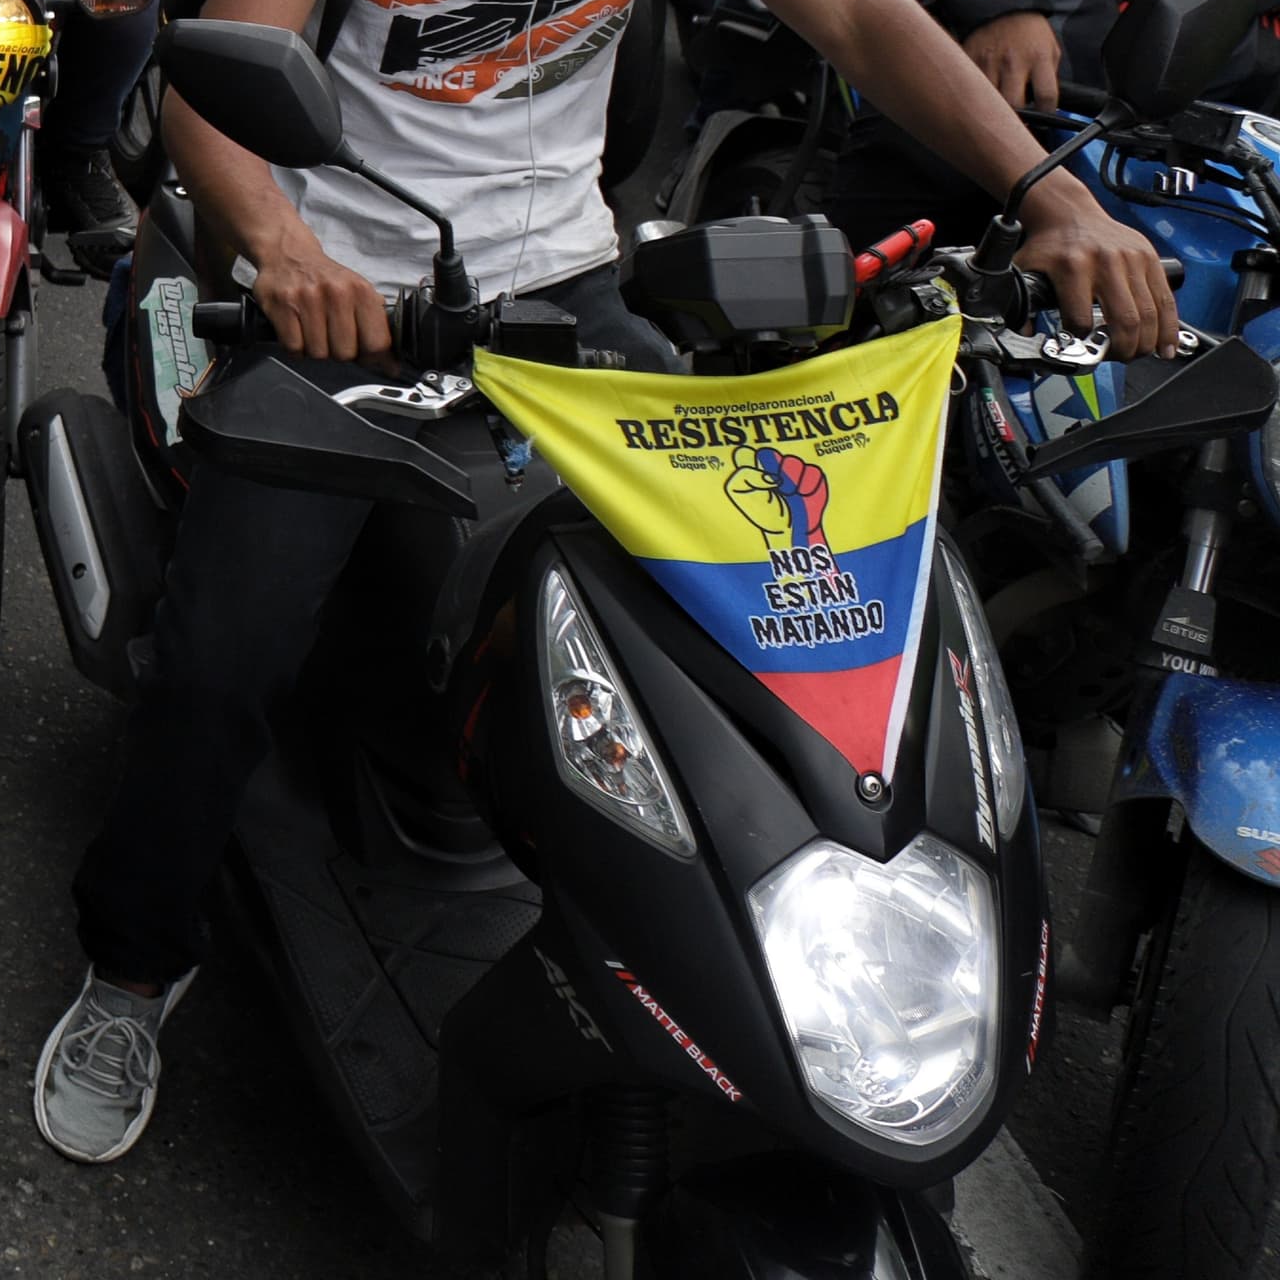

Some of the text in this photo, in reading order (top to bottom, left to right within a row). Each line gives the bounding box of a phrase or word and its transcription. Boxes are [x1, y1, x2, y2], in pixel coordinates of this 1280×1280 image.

[615, 391, 899, 451] RESISTENCIA
[673, 391, 836, 418] #yoapoyoelparonacional
[770, 545, 832, 578] NOS
[763, 573, 857, 613] ESTAN
[750, 602, 883, 648] MATANDO
[1160, 651, 1196, 674] YOU
[1236, 825, 1280, 845] SUZ
[1030, 919, 1050, 1041] MATTE BLACK
[631, 985, 743, 1102] MATTE BLACK
